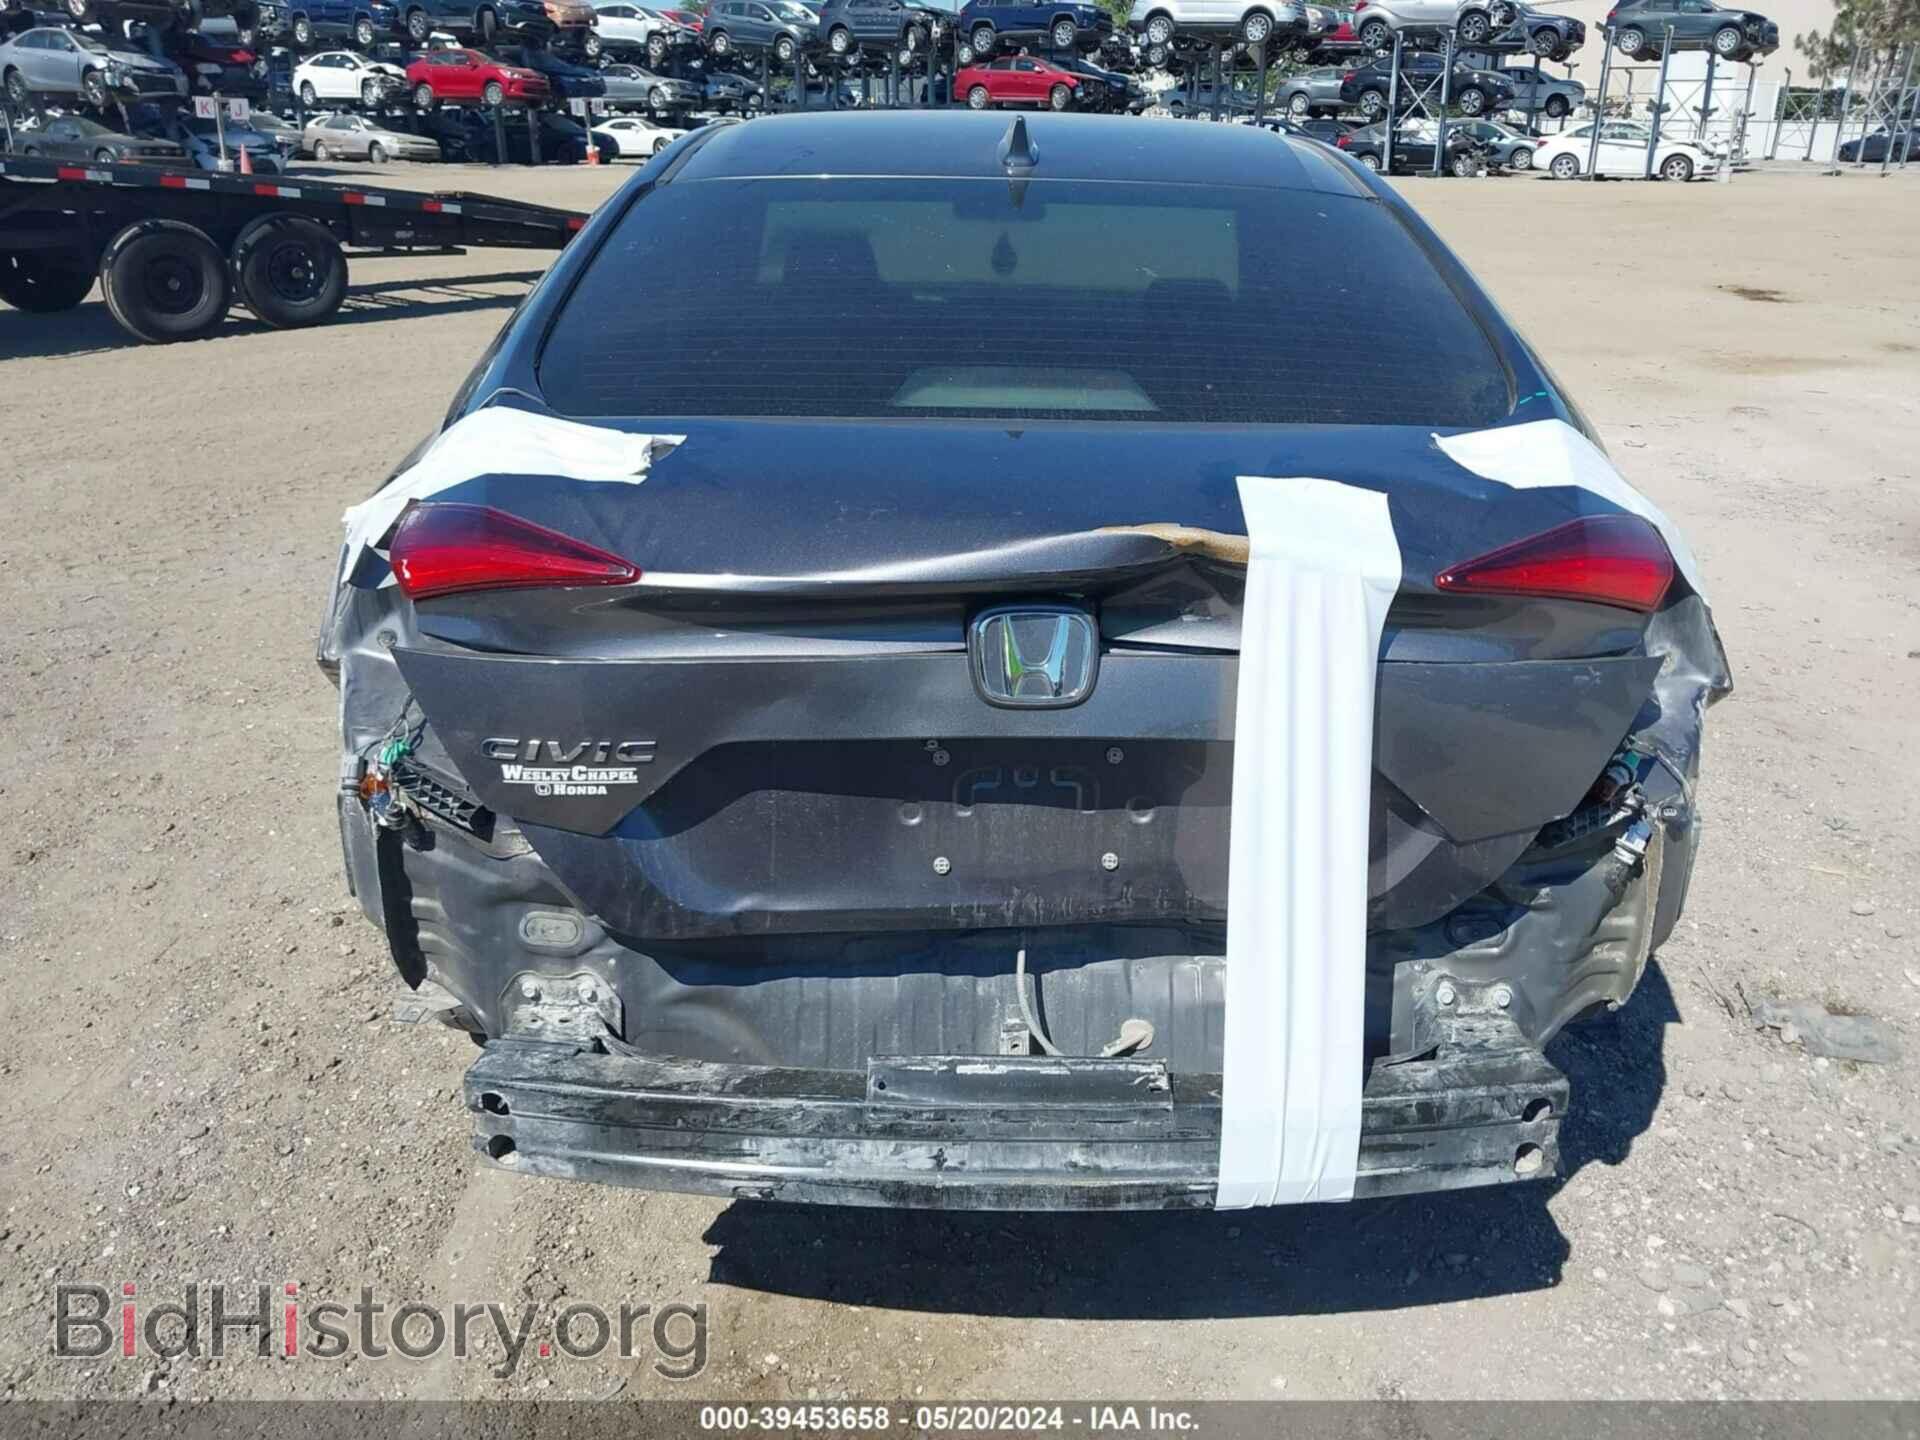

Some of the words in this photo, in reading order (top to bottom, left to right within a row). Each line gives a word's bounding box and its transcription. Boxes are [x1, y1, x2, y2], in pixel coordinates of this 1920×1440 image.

[481, 737, 657, 763] CIVIC
[501, 764, 570, 781] WESLEY
[571, 765, 638, 782] CHAPEL
[553, 783, 608, 796] HONDA
